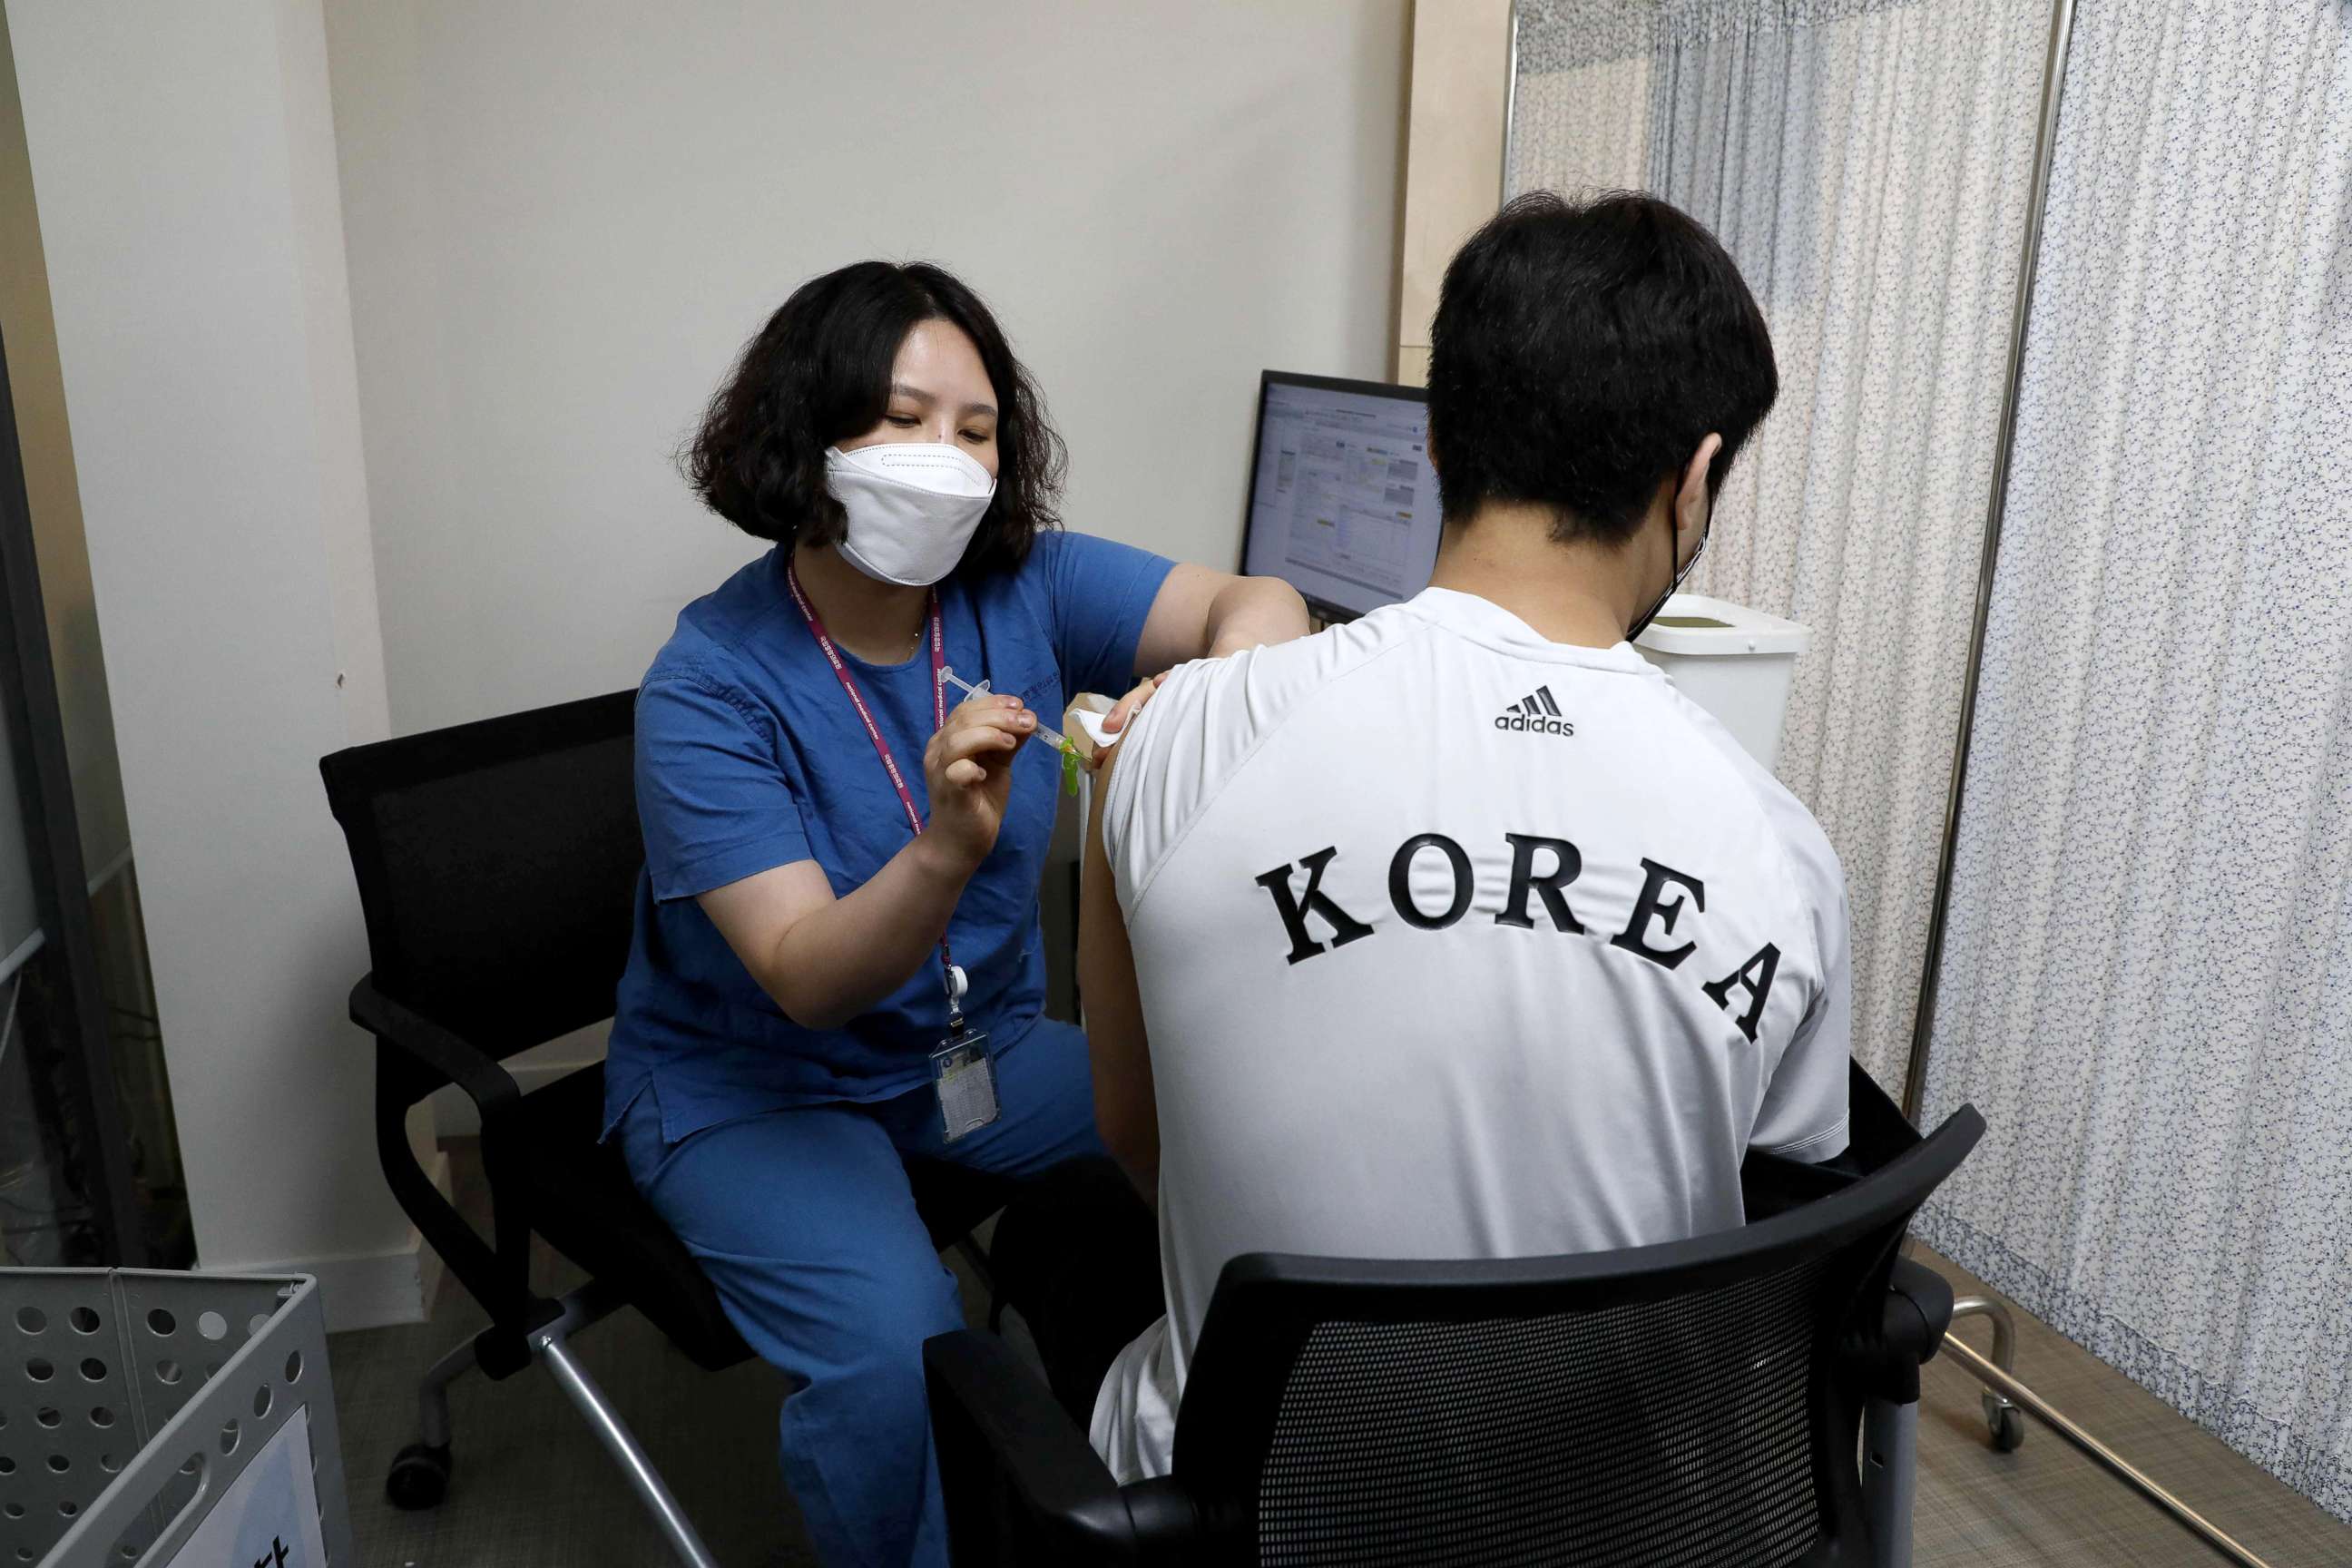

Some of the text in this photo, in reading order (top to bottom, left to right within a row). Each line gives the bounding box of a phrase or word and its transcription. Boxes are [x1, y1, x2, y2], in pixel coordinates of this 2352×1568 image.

[846, 681, 879, 740] national medical center
[1494, 713, 1574, 737] adidas
[906, 801, 917, 824] national
[1255, 832, 1782, 1044] KOREA
